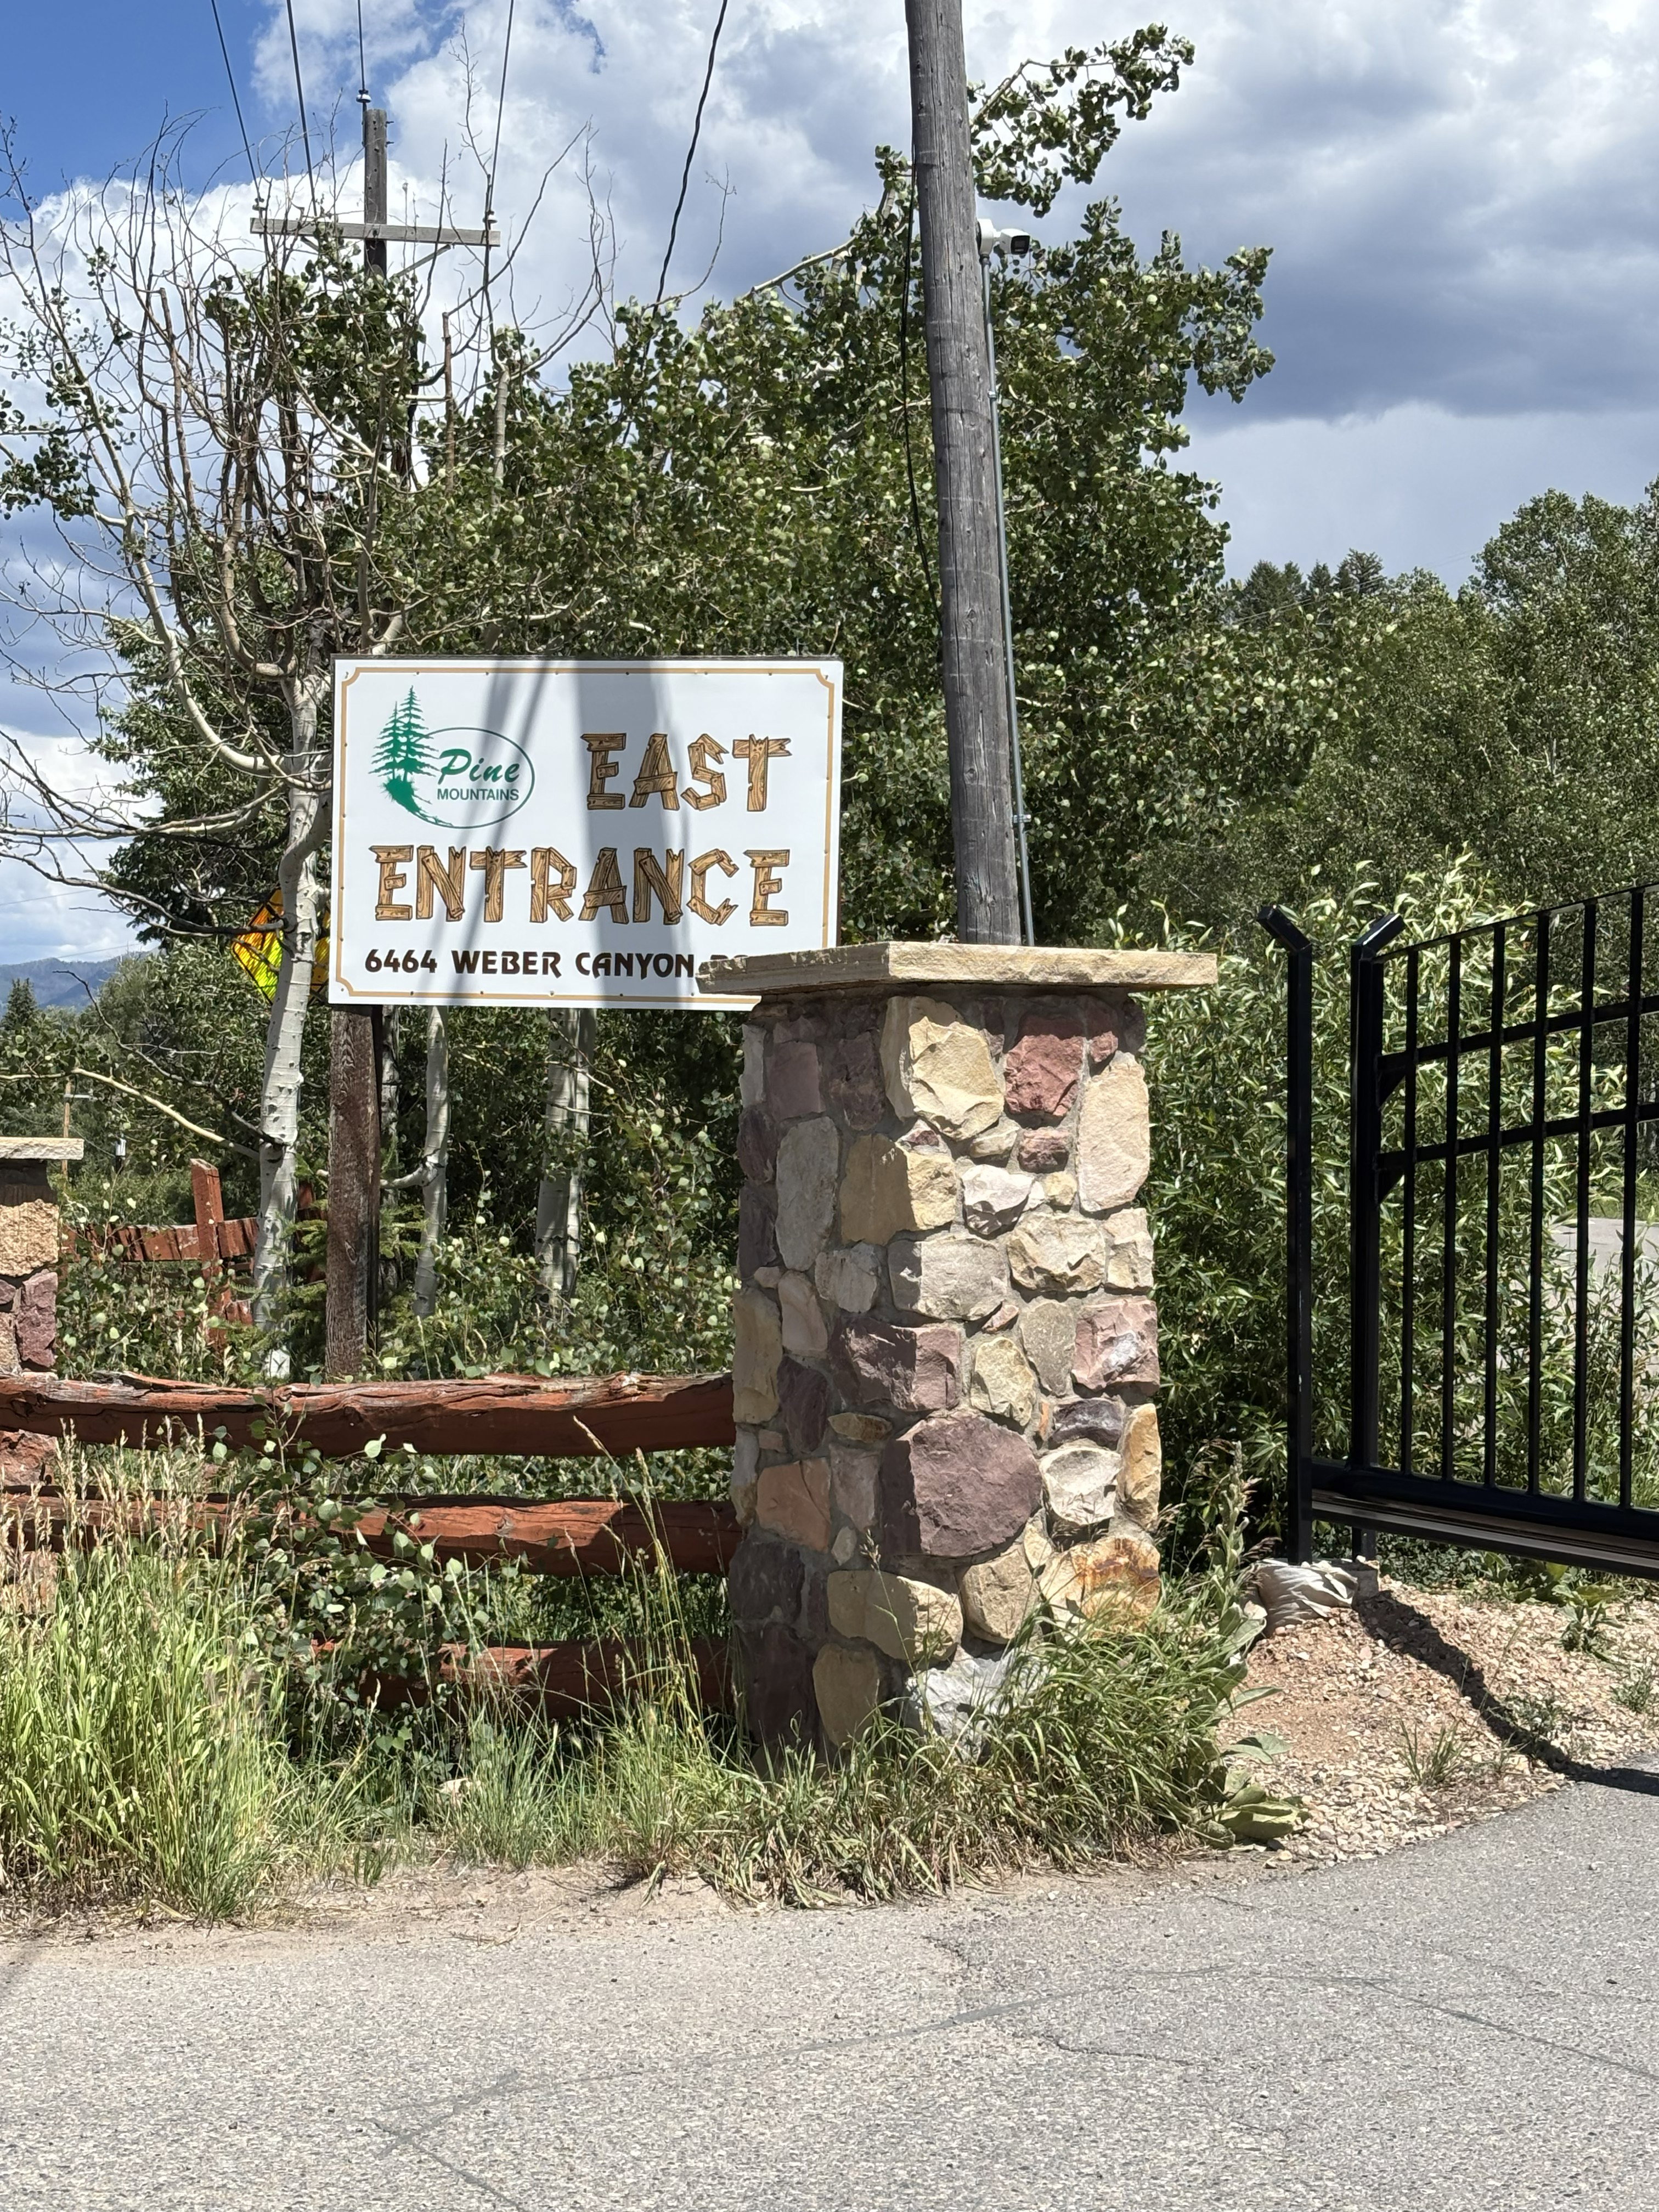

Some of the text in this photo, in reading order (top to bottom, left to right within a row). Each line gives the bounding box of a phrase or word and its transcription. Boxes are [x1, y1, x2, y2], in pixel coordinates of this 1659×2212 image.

[438, 748, 520, 785] Pine
[580, 733, 792, 811] EAST
[437, 788, 520, 801] MOUNTAINS
[369, 845, 790, 926] ENTRANCE
[365, 949, 695, 980] 6464 WEBER CANYON
